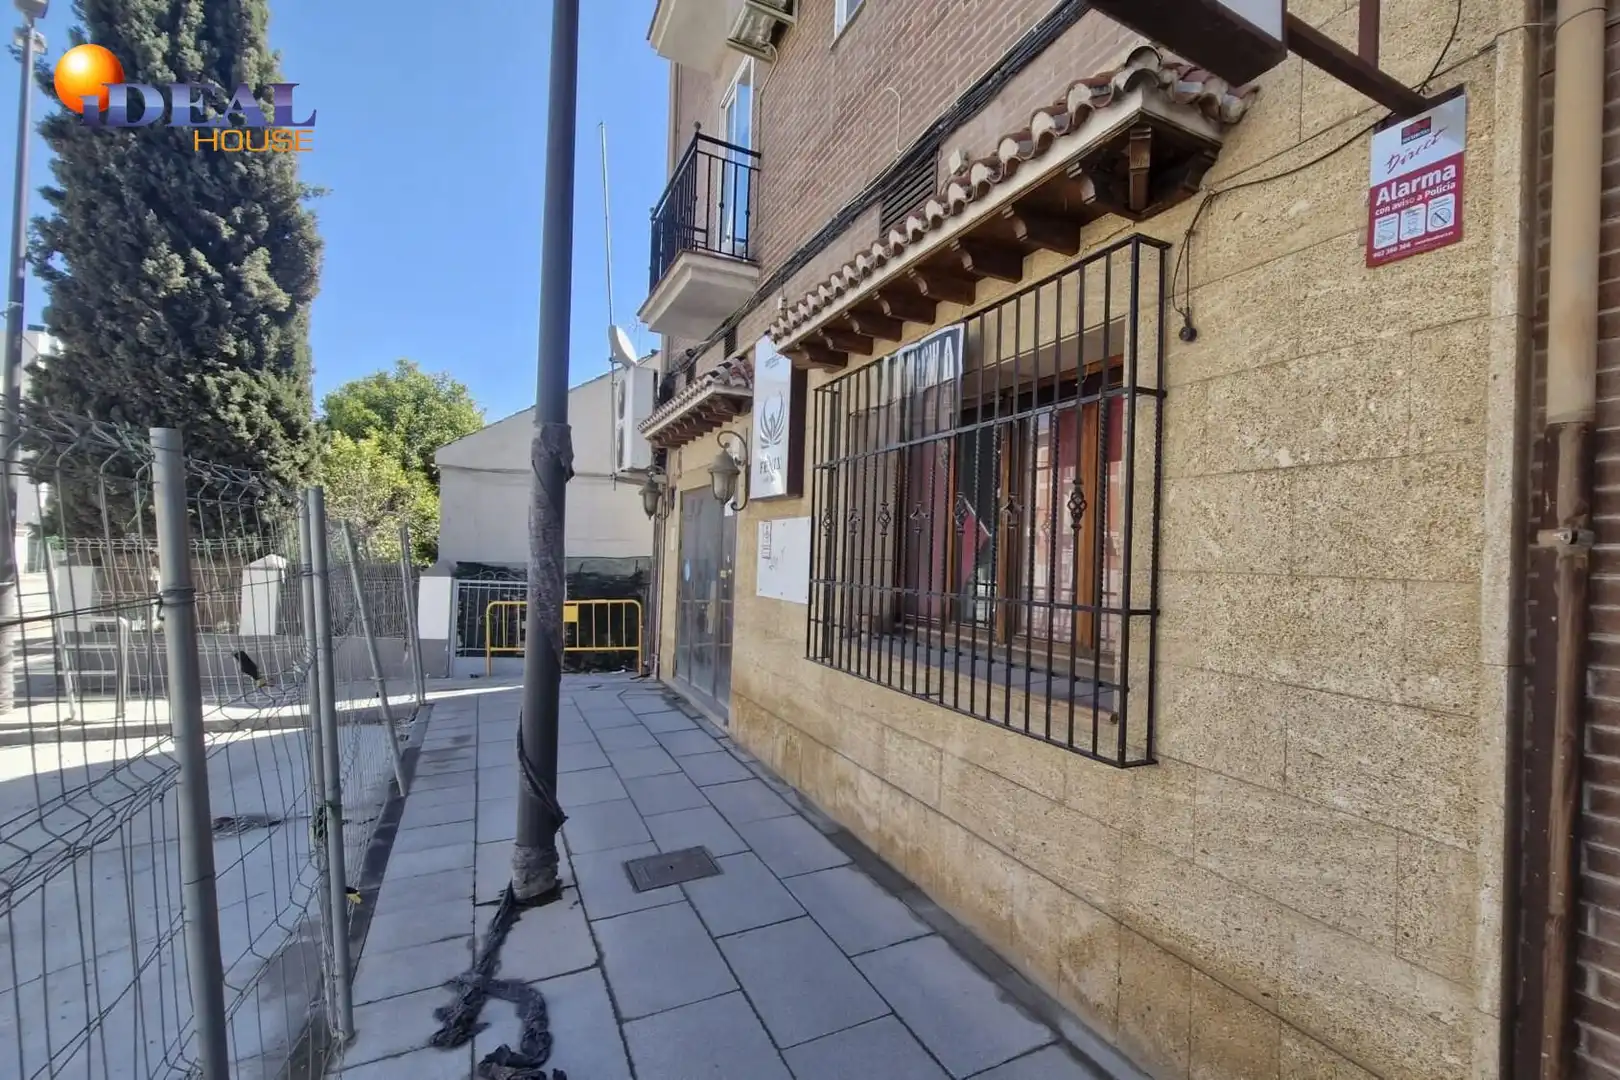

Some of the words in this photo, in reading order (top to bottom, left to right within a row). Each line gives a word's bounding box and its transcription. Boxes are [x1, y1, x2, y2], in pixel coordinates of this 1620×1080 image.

[1376, 164, 1456, 206] Alarma
[1375, 206, 1390, 216] con
[1391, 197, 1415, 211] aviso
